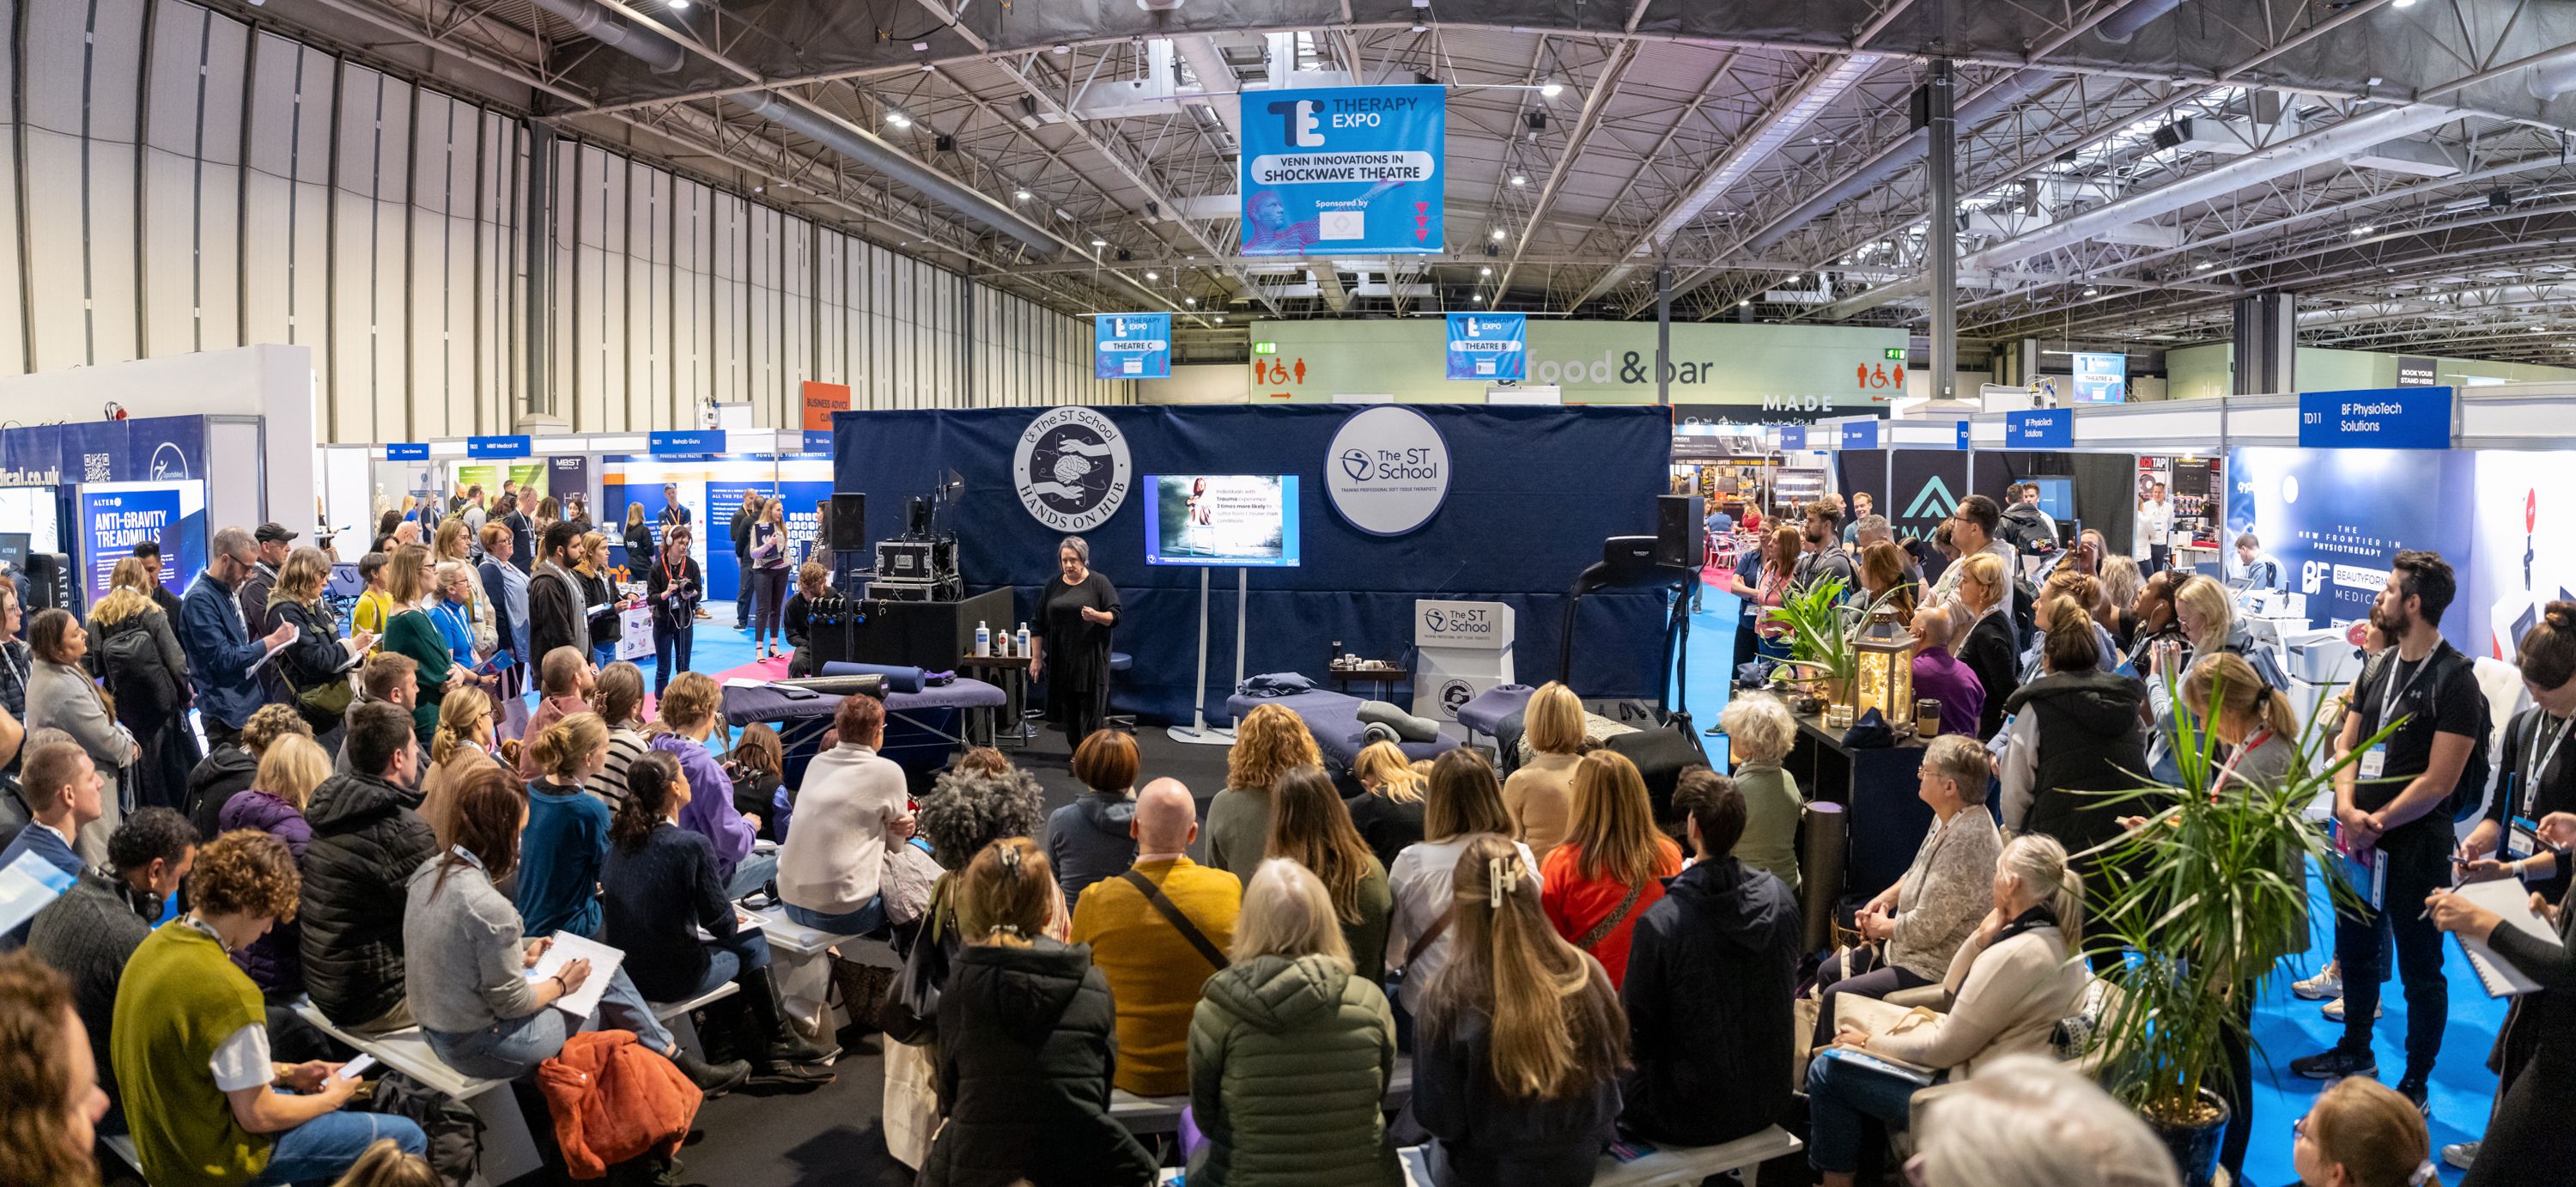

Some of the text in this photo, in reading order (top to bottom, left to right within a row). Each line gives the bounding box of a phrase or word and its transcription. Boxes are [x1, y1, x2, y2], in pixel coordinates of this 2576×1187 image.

[1333, 97, 1418, 113] THERAPY
[1333, 113, 1381, 128] EXPO
[1280, 155, 1404, 167] VENN INNOVATIONS IN
[1265, 167, 1420, 182] SHOCKWAVE THEATRE
[1315, 199, 1368, 208] Sponsored by
[1525, 350, 1612, 383] food
[1620, 350, 1648, 384] &
[807, 399, 848, 410] BUSINESS ADVICE
[1762, 394, 1832, 412] MADE
[2342, 402, 2402, 417] BF PhysioTech
[1034, 410, 1118, 441] The ST School
[2031, 418, 2053, 428] PhysioTech
[2304, 412, 2322, 424] TD11
[2025, 429, 2043, 438] Solutions
[2341, 420, 2380, 432] Solutions
[1377, 448, 1431, 465] The ST
[1379, 462, 1437, 479] School
[1020, 482, 1125, 529] HANDS ON HUB
[94, 510, 167, 532] ANTI-GRAVITY
[2337, 525, 2357, 534] THE
[95, 528, 161, 548] TREADMILLS
[2326, 533, 2381, 547] FRONTIER
[2313, 542, 2381, 557] PHYSIOTHERAPY
[2302, 560, 2330, 595] BF
[1450, 610, 1487, 621] The ST
[1450, 620, 1492, 633] School
